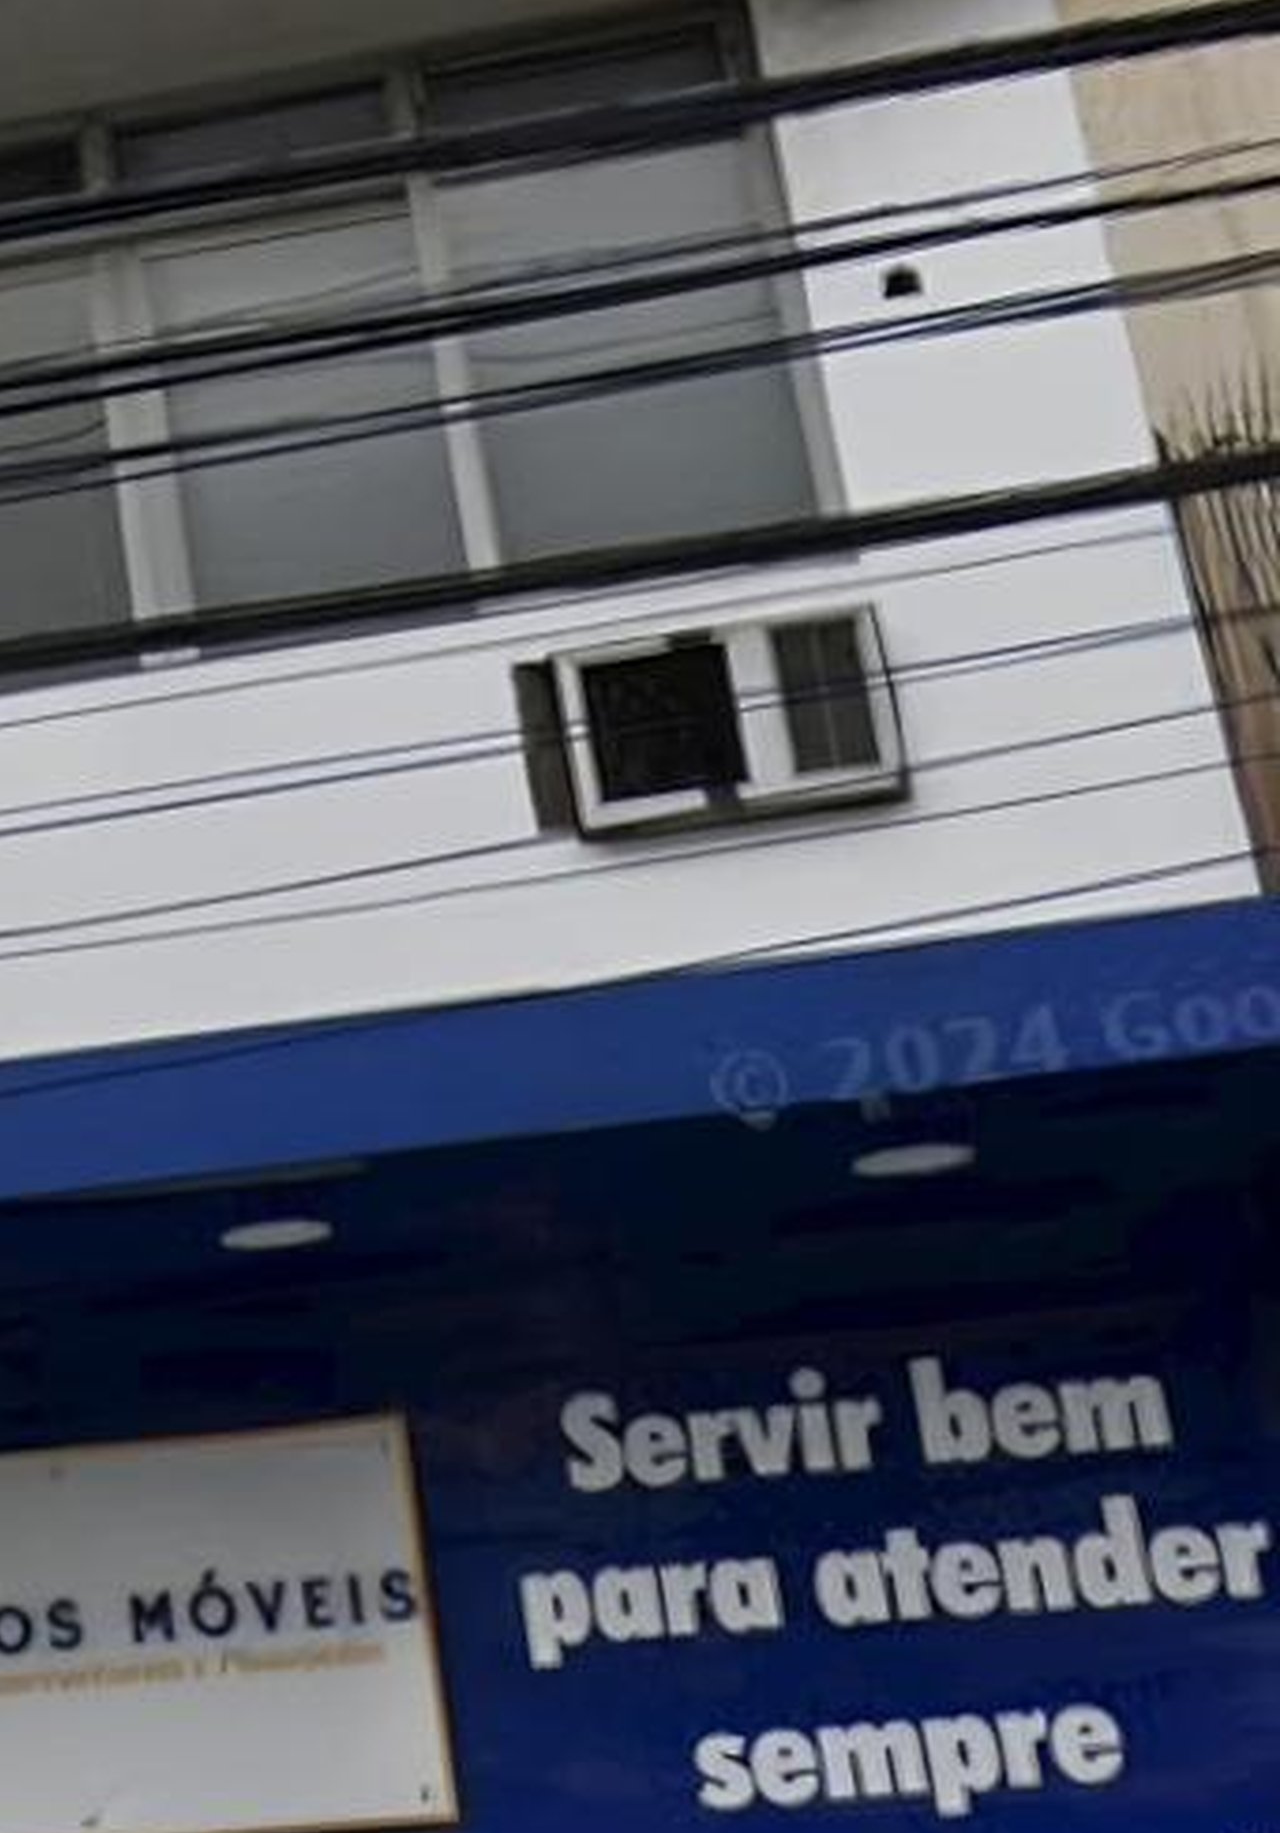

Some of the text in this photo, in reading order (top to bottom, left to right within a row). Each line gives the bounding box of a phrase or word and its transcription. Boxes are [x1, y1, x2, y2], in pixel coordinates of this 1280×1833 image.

[561, 1356, 1174, 1493] Servir bem
[130, 1567, 418, 1645] MÓVEIS
[520, 1494, 1271, 1671] para atender
[693, 1703, 1126, 1819] sempre
